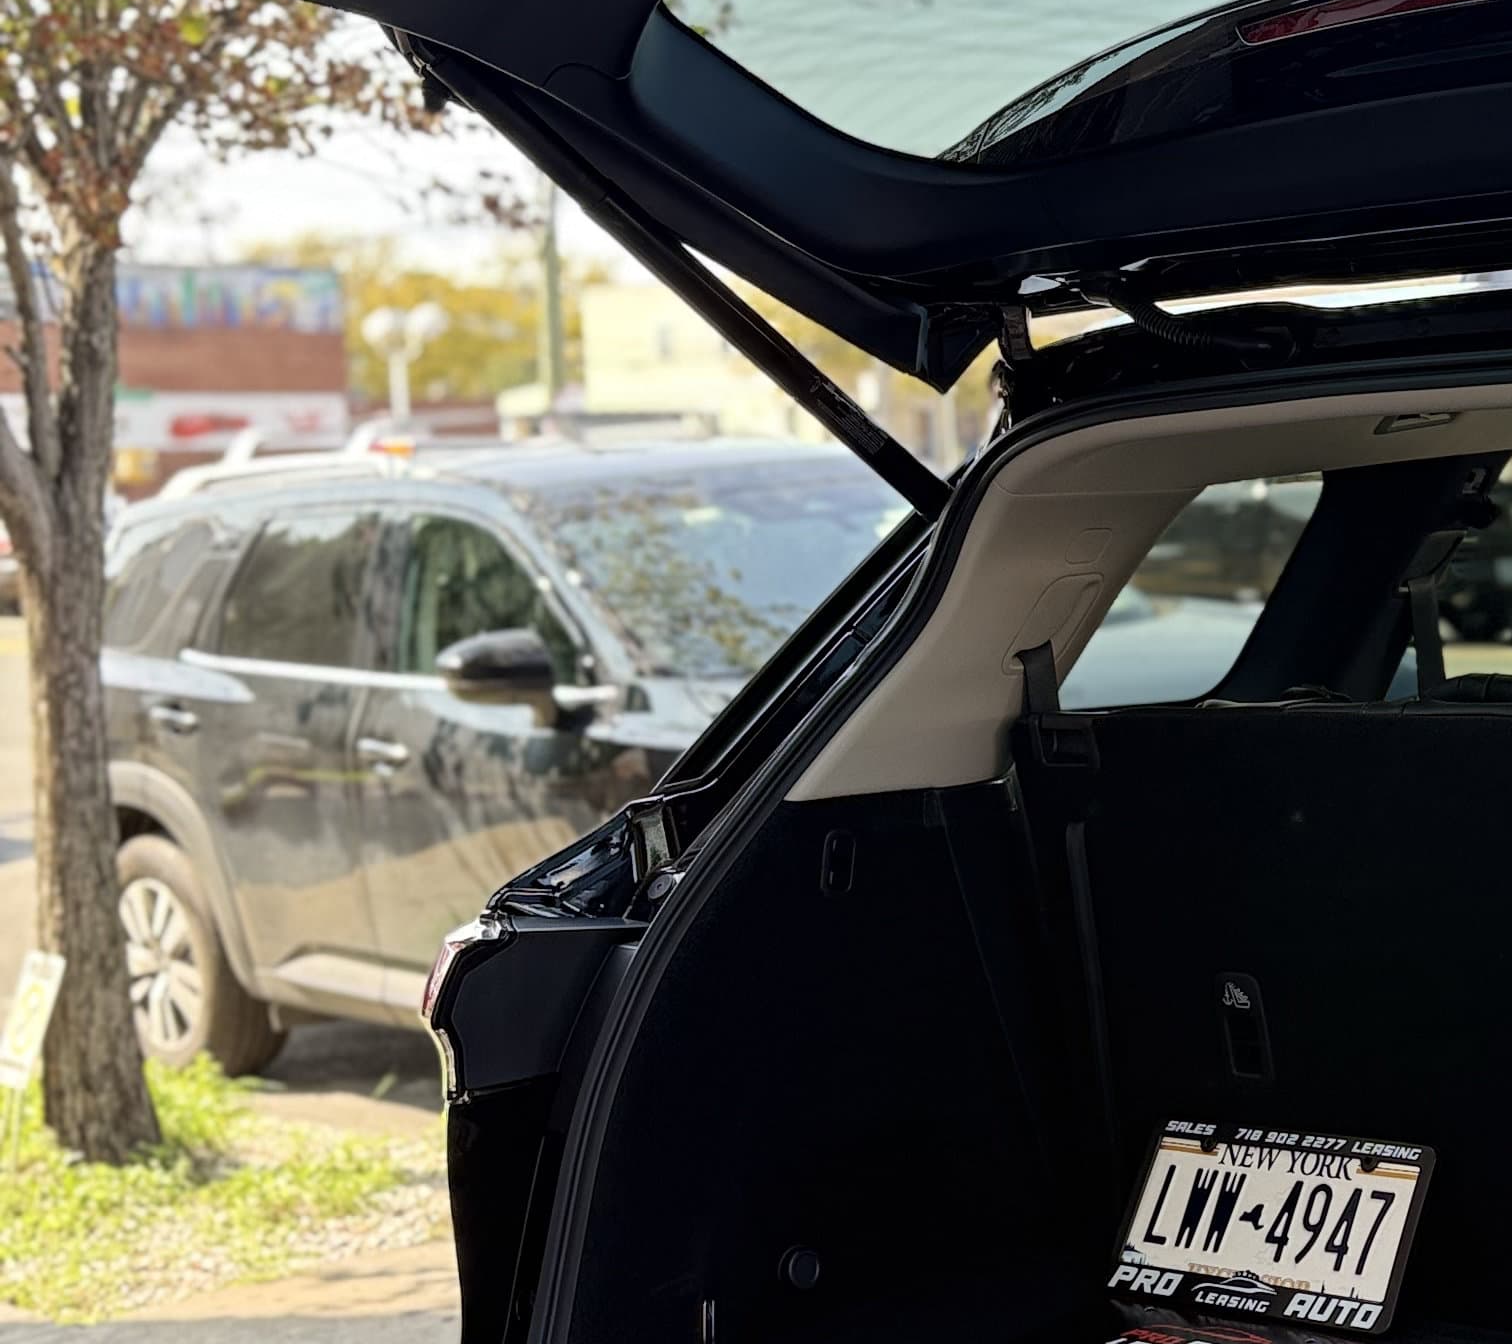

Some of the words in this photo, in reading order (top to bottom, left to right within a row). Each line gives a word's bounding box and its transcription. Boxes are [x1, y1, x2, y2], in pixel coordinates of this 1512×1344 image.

[1165, 1119, 1217, 1136] SALES
[1234, 1128, 1262, 1141] 718
[1264, 1131, 1298, 1146] 902
[1301, 1136, 1347, 1151] 2277
[1351, 1141, 1422, 1161] LEASING
[1218, 1143, 1281, 1171] NEW
[1286, 1151, 1353, 1181] YORK
[1264, 1179, 1397, 1277] 4947
[1107, 1264, 1184, 1297] PRO
[1194, 1290, 1271, 1313] LEASING
[1283, 1293, 1384, 1330] AUTO
